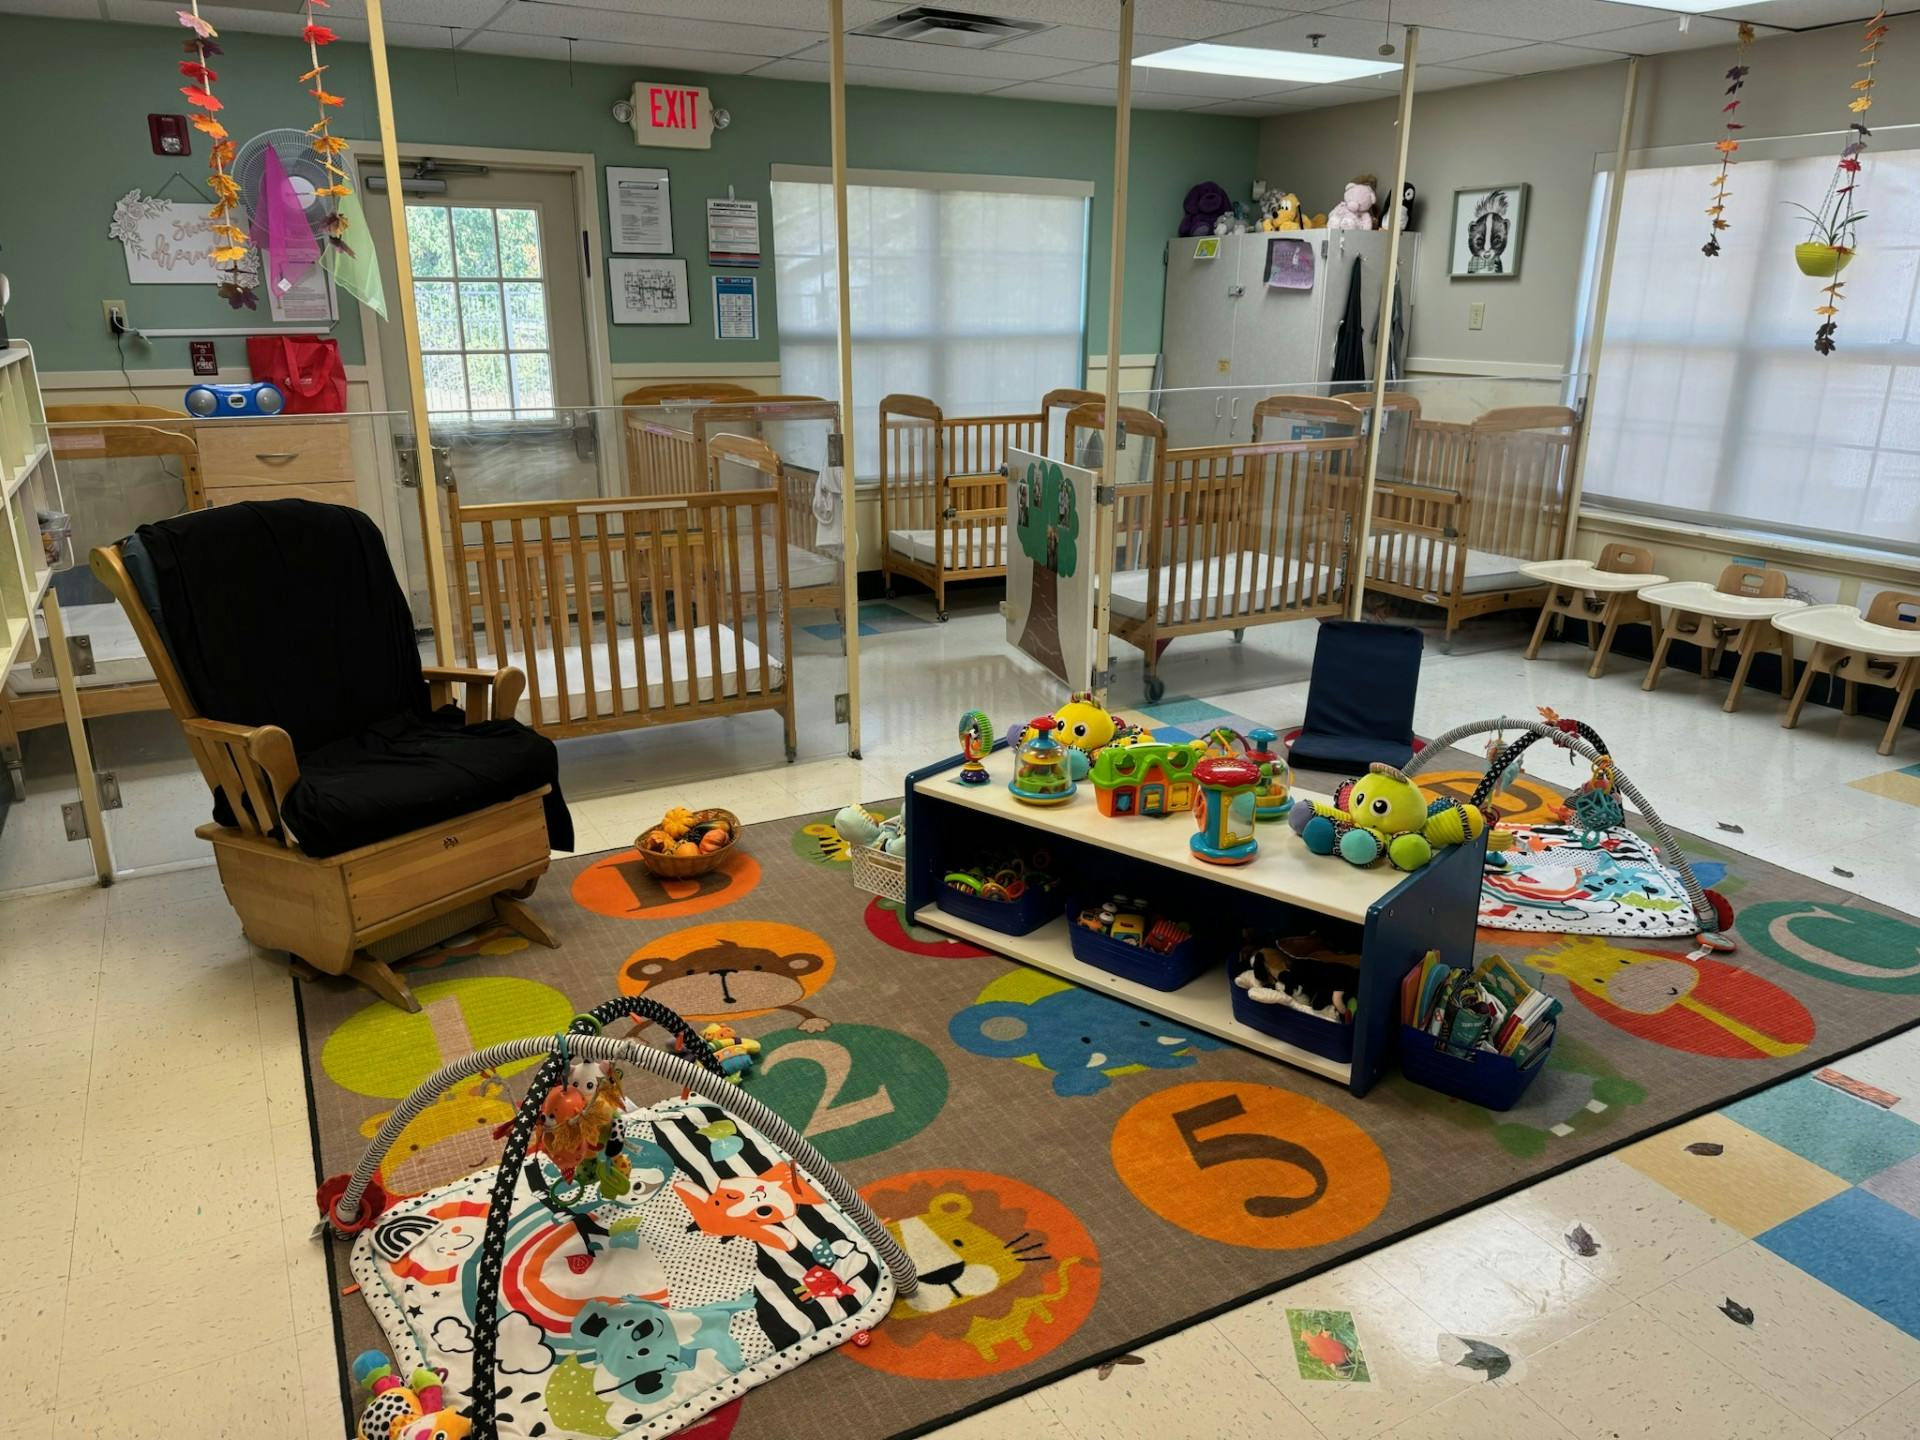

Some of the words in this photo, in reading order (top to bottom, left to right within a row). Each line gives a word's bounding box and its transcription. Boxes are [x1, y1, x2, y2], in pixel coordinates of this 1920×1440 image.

[649, 88, 700, 130] EXIT
[151, 233, 224, 271] dream
[171, 215, 230, 242] Swee
[1767, 905, 1920, 978] C
[760, 1038, 896, 1136] 2
[1171, 1093, 1328, 1218] 5
